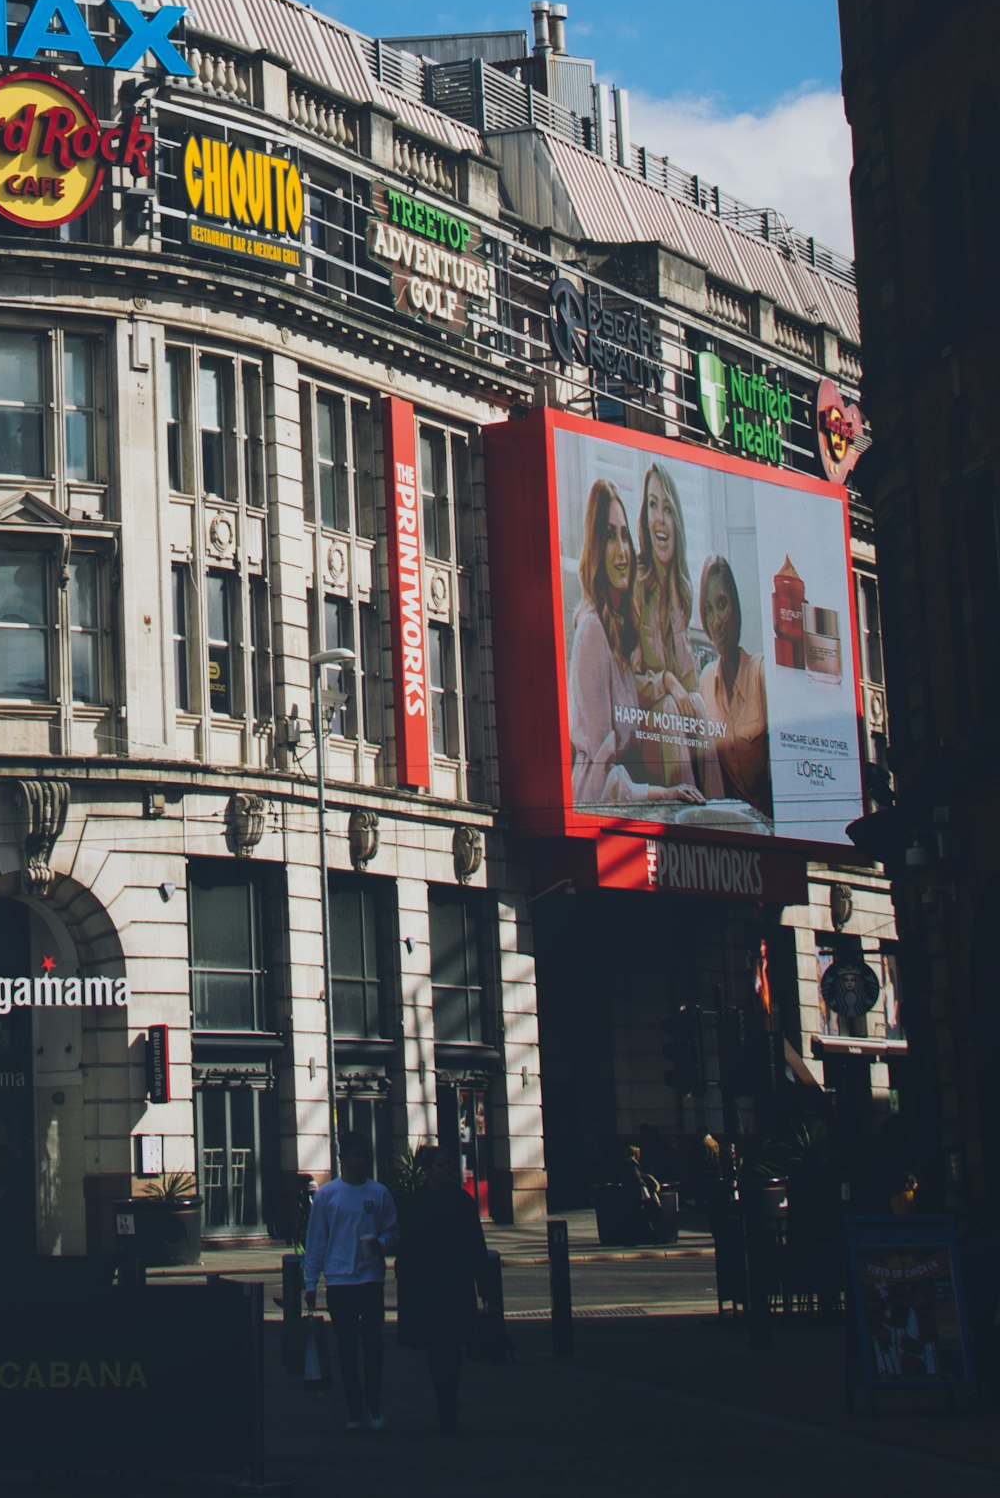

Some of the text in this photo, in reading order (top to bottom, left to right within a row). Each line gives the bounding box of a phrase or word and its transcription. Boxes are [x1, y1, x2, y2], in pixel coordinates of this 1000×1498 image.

[39, 108, 154, 177] Rock
[5, 173, 65, 199] CAFE
[184, 135, 303, 236] CHIQUITO
[190, 225, 301, 267] RESTAURANT BAR & MEXICAN GRILL
[389, 189, 471, 252] TREETOP
[374, 223, 489, 300] ADVENTURE
[411, 277, 457, 321] GOLF
[589, 332, 664, 393] REALITY
[729, 363, 792, 425] Nuffield
[732, 414, 784, 467] Health
[395, 462, 424, 717] THE PRINTWORKS
[614, 705, 727, 738] HAPPY MOTHER'S DAY
[635, 730, 660, 742] BECAUSE
[683, 737, 702, 748] WORTH
[780, 731, 807, 745] SKINCARE
[808, 736, 820, 747] LIKE
[820, 737, 829, 748] NO
[809, 779, 825, 787] PARIS
[646, 839, 763, 895] THE PRINTWORKS
[153, 1031, 163, 1096] wagamama
